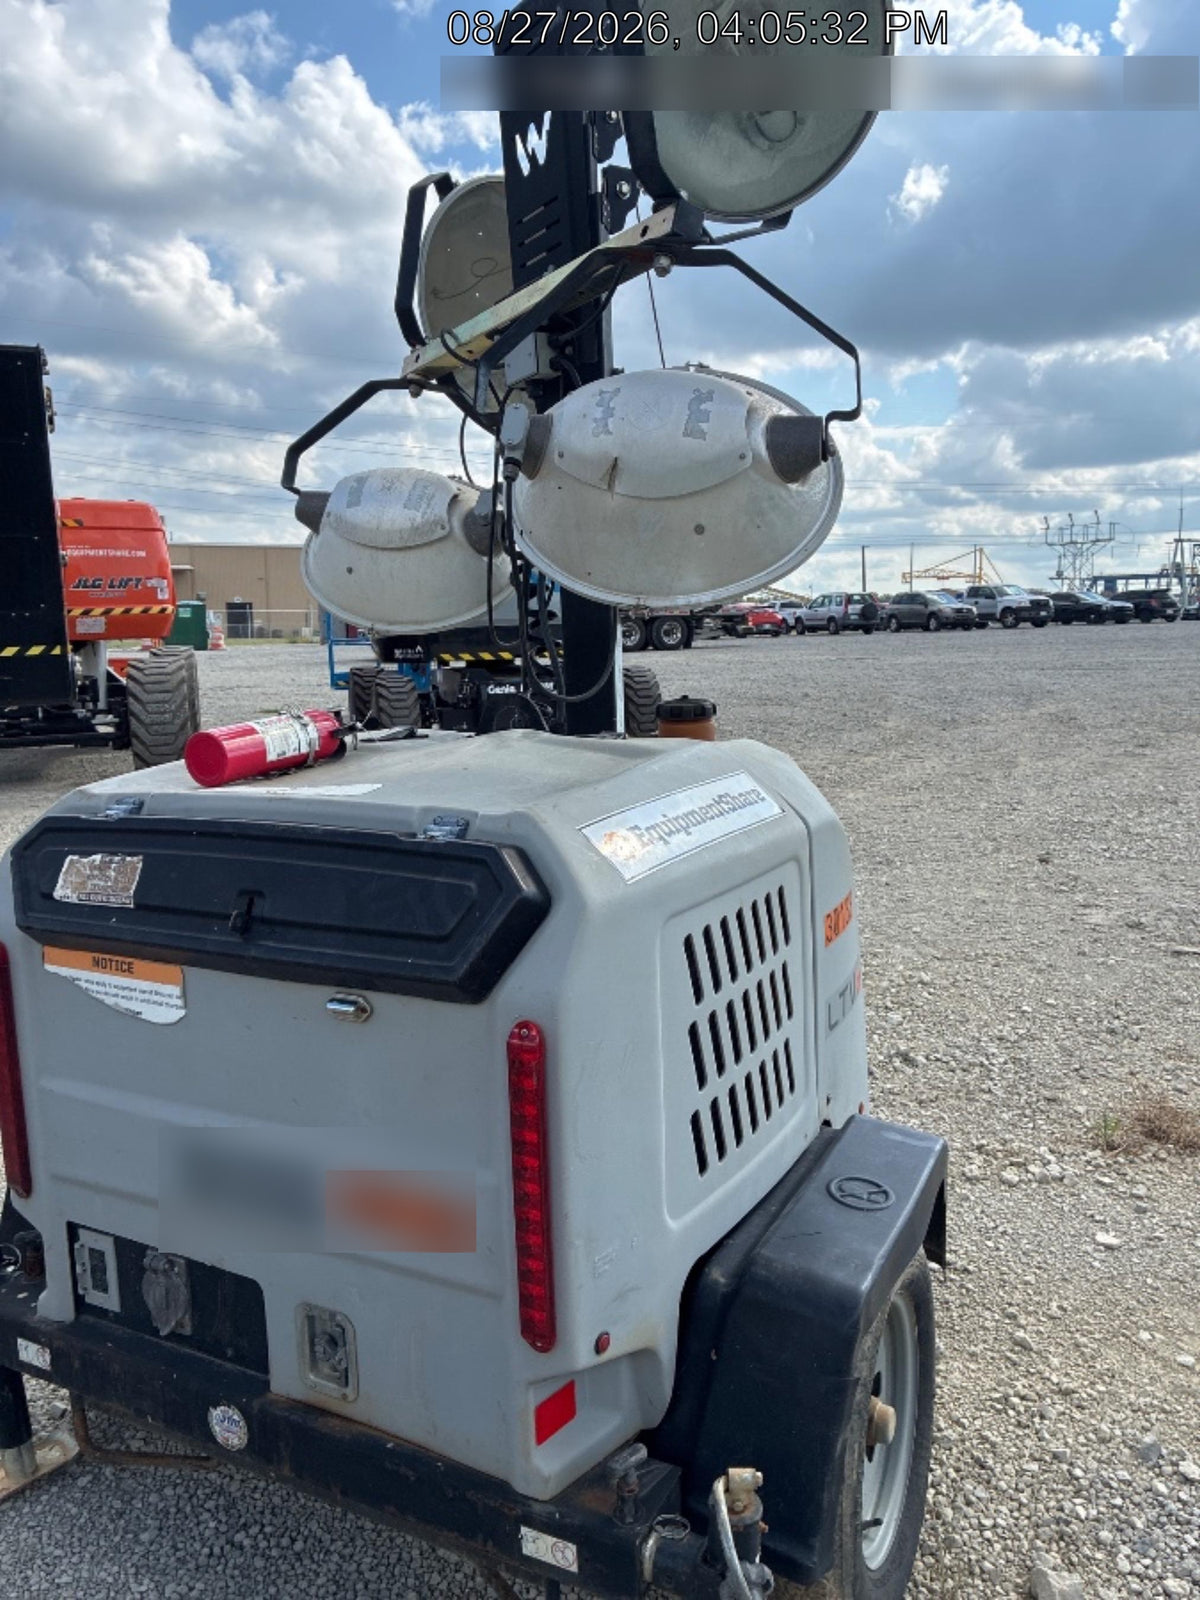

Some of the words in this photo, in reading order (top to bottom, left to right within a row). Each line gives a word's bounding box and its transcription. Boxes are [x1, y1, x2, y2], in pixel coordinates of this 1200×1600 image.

[70, 577, 103, 590] JLG
[107, 577, 144, 590] LIFT
[488, 683, 517, 694] Genie
[629, 787, 765, 846] EquipmentShare
[92, 956, 135, 975] NOTICE
